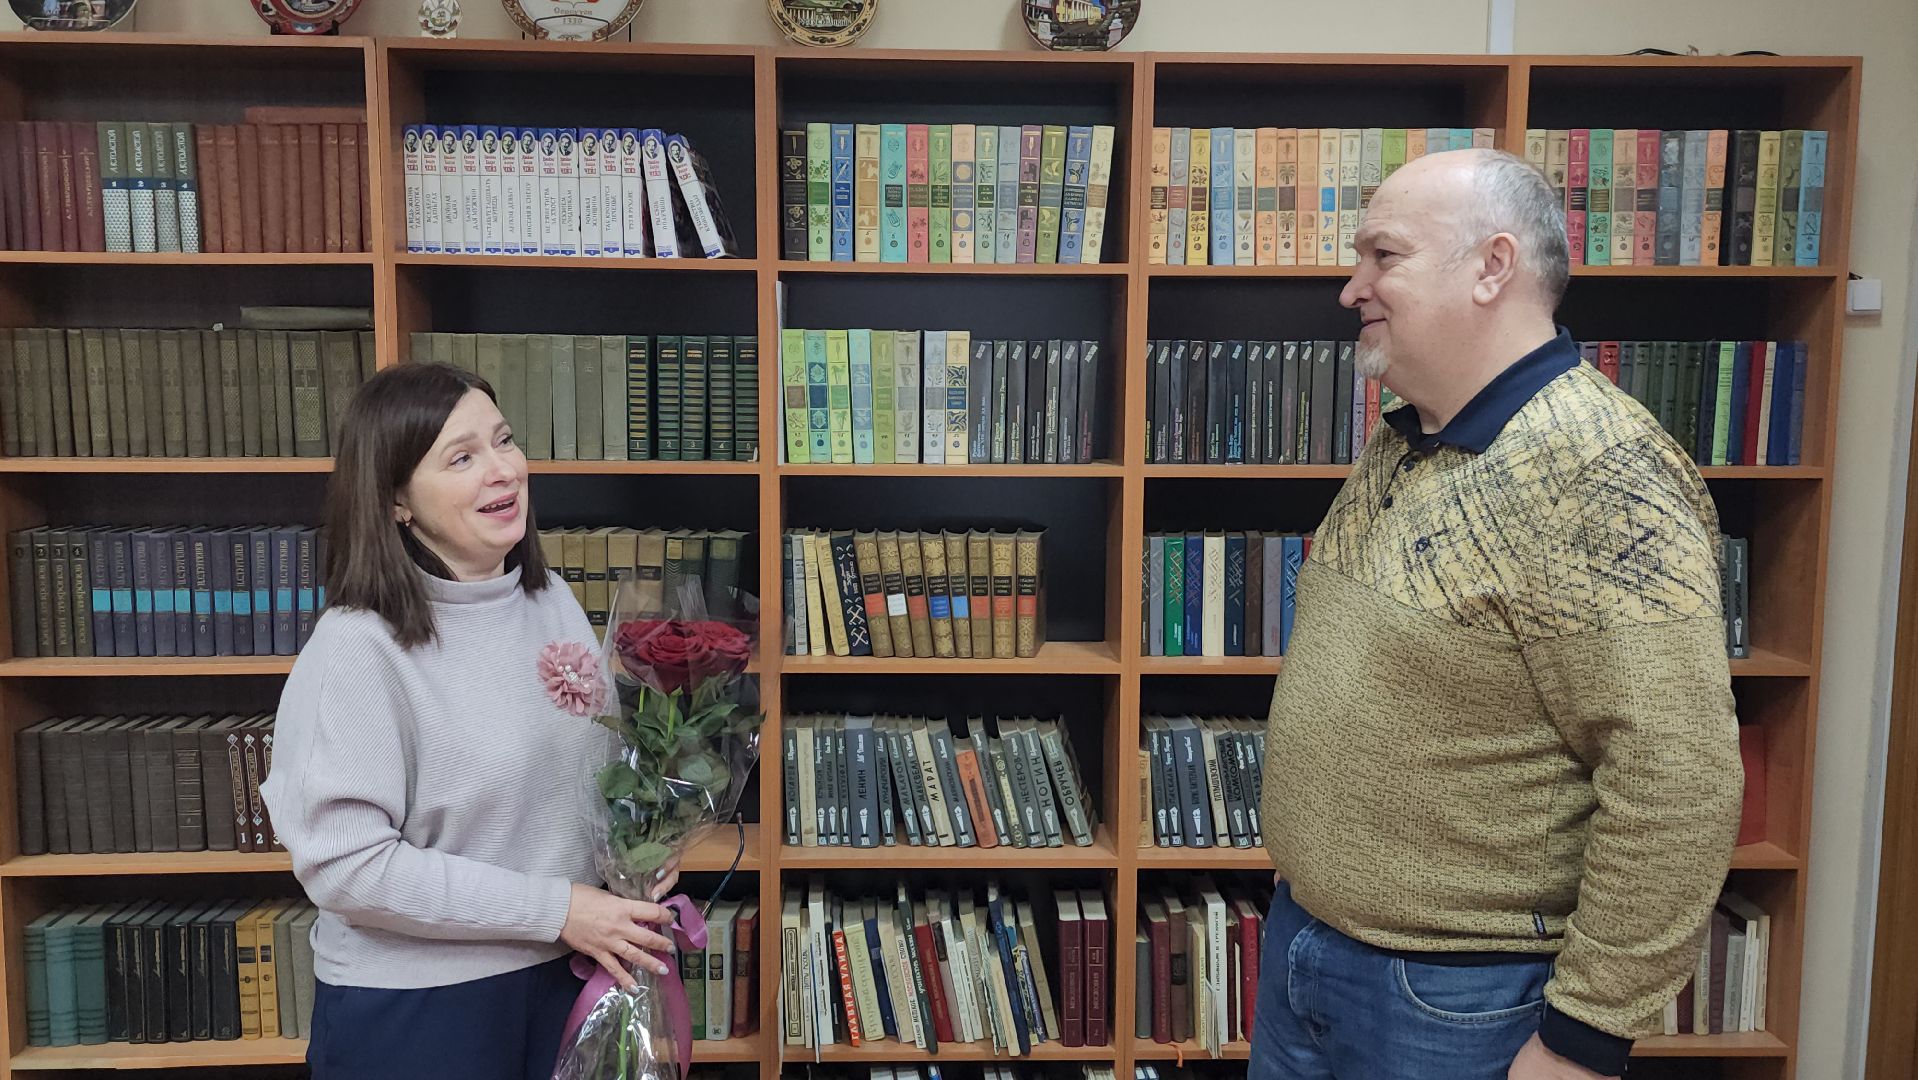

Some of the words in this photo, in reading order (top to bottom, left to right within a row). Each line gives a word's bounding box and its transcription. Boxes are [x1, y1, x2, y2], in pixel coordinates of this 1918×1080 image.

[200, 624, 207, 634] 6
[857, 769, 868, 800] ЛЕНИН
[922, 759, 940, 802] МАРАТ
[1013, 756, 1031, 804] НЕСТЕРОВ
[1030, 755, 1052, 808] НОГИН
[1053, 759, 1075, 806] ОБРУЧЕВ
[1224, 736, 1242, 801] КОМСОМОЛА
[240, 832, 247, 844] 1
[255, 833, 264, 845] 2
[272, 834, 281, 845] 3
[836, 936, 849, 981] УЛИЦА
[844, 983, 860, 1041] ГЛАВНАЯ
